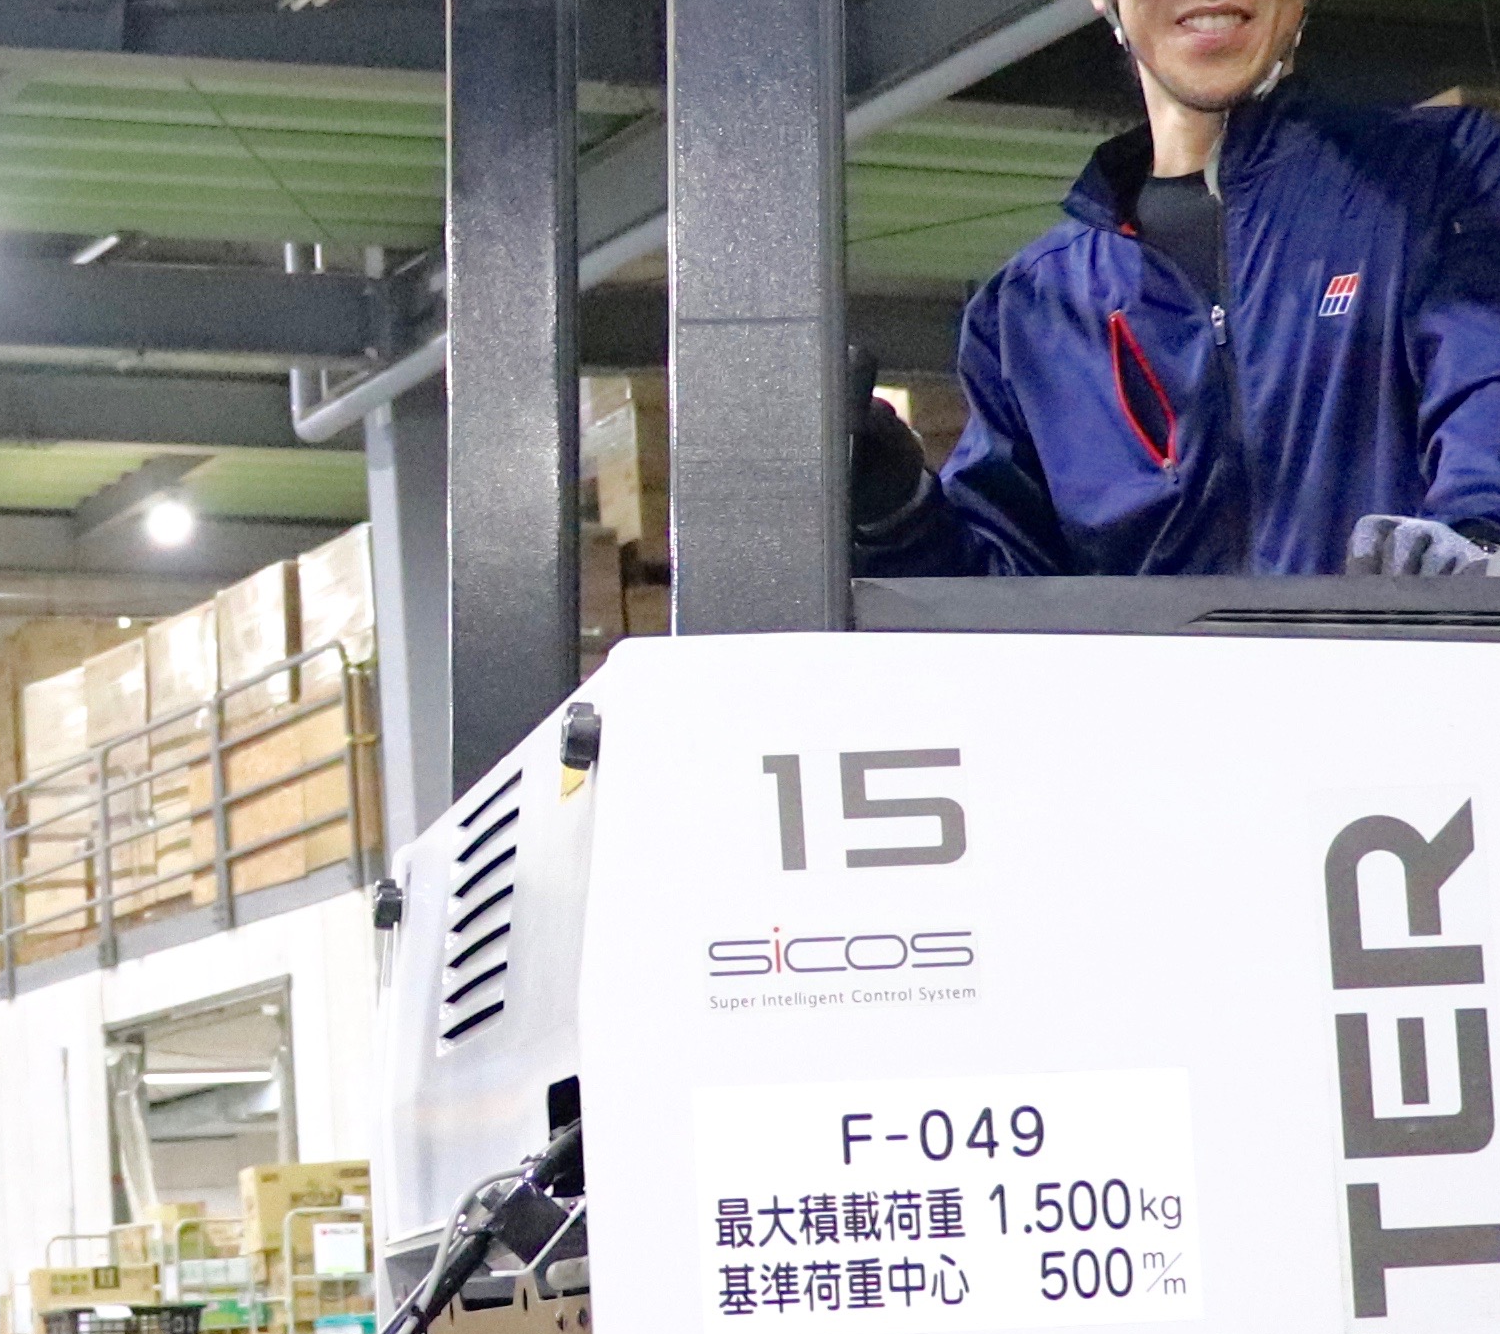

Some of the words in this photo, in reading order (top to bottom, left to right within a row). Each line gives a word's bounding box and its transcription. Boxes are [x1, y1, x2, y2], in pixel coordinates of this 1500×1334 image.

[762, 748, 967, 870] 15
[709, 994, 755, 1011] Super
[762, 991, 844, 1008] Intelligent
[851, 987, 912, 1004] Control
[919, 985, 977, 1002] System
[841, 1105, 1045, 1165] F-049
[715, 1187, 967, 1249] 最大積載荷重
[718, 1253, 970, 1315] 基準荷重中心
